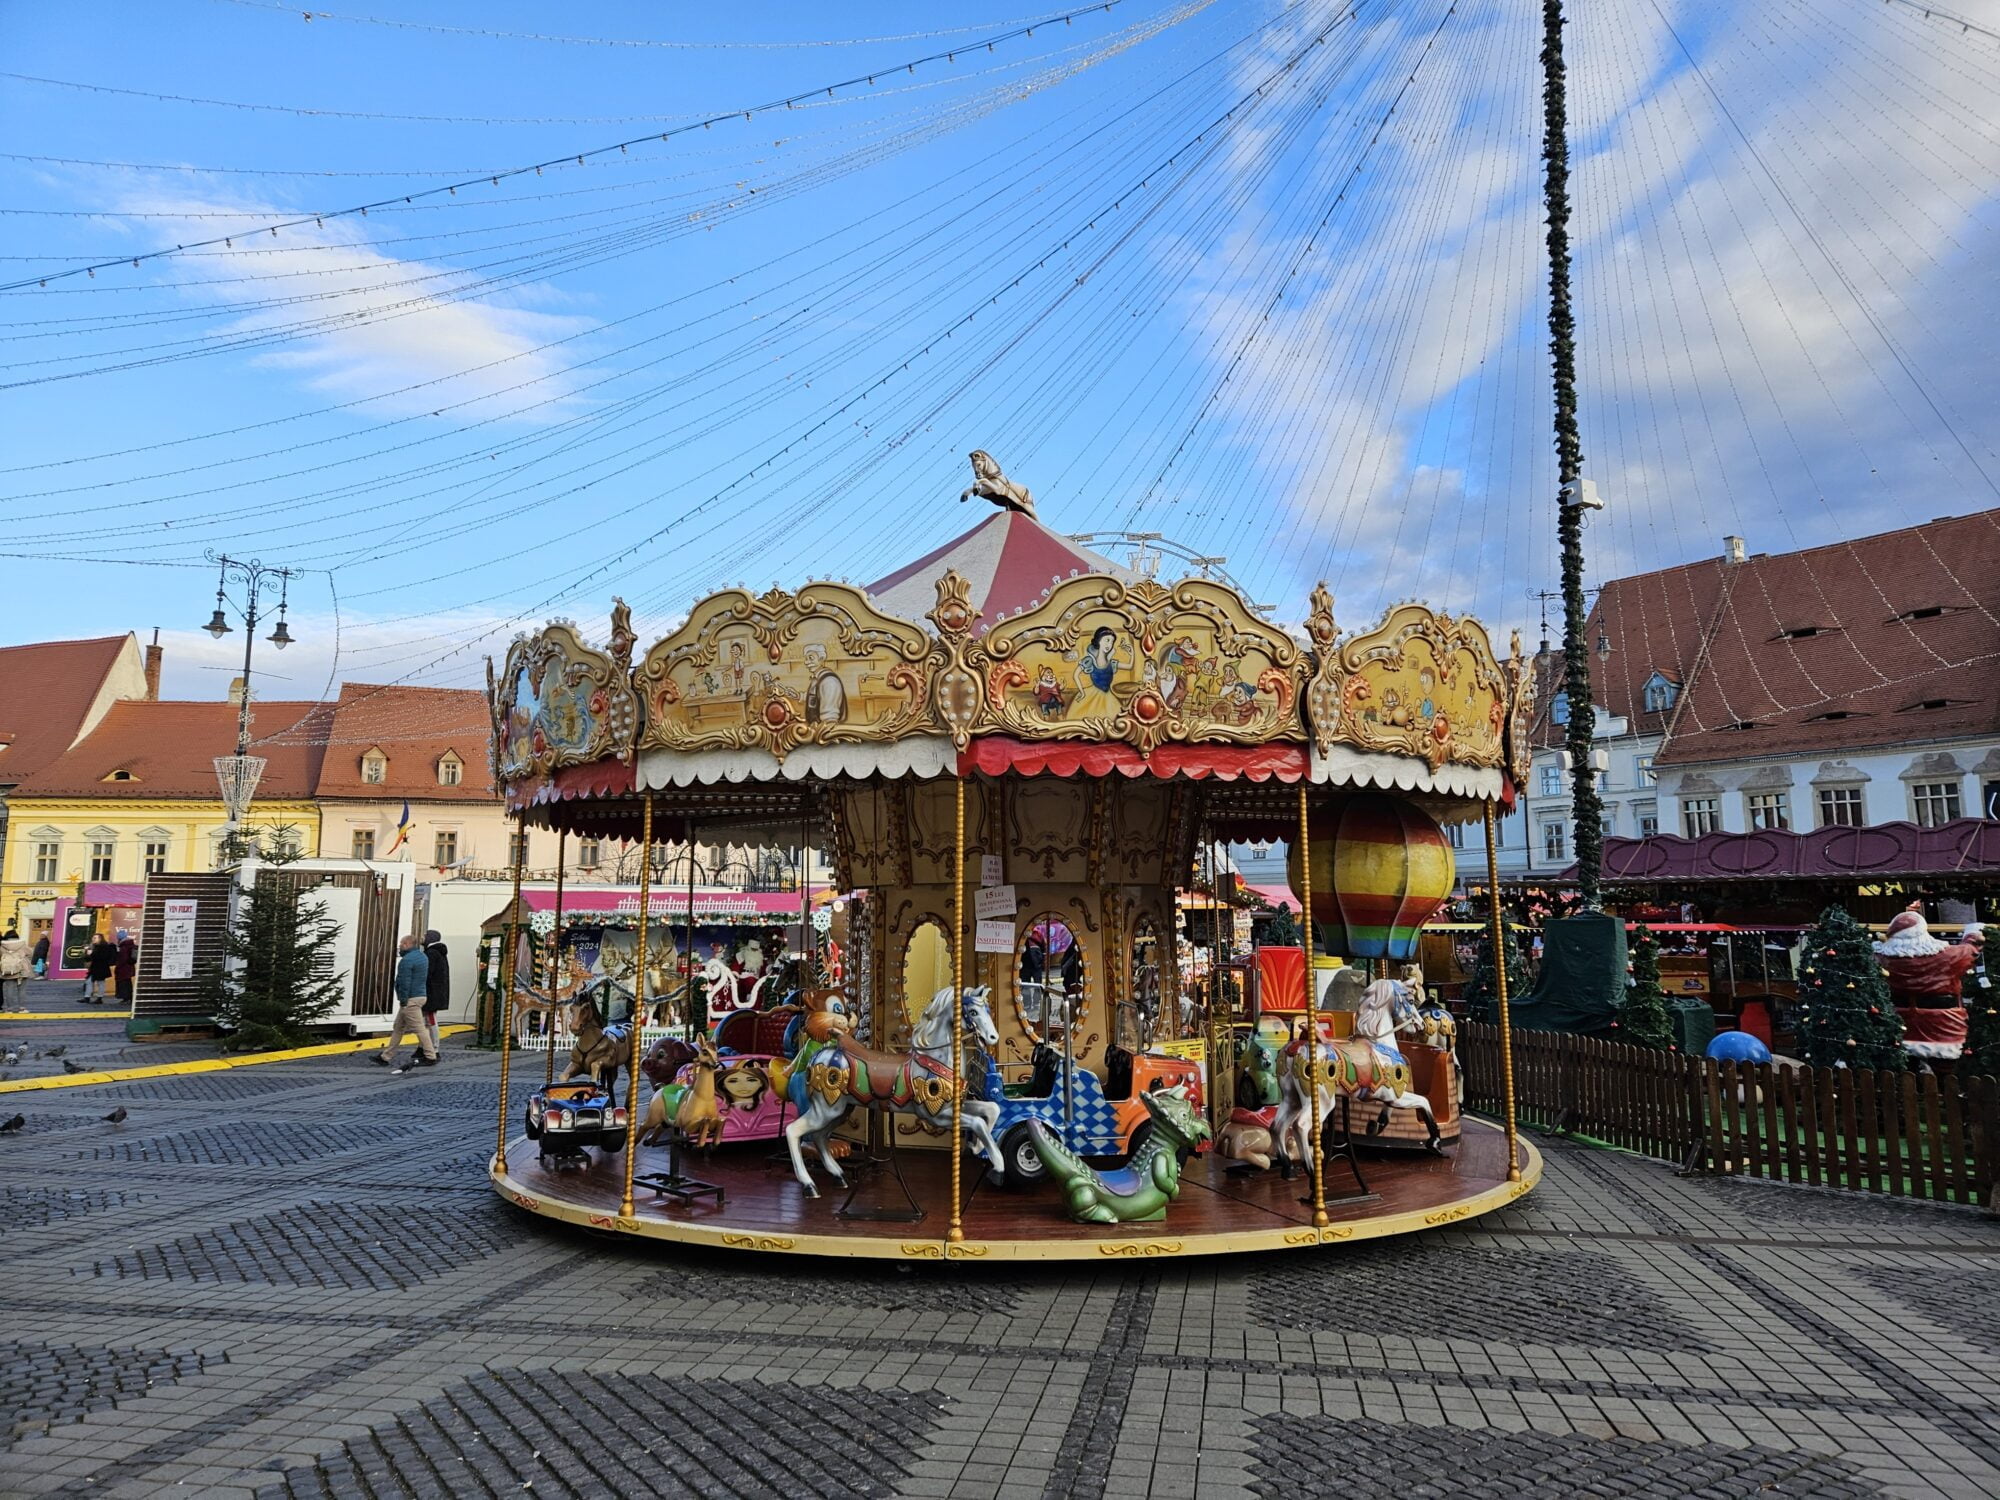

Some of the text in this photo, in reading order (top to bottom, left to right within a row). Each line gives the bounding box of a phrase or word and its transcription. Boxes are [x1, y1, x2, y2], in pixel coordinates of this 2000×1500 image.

[458, 869, 486, 879] Hotel
[985, 891, 994, 899] 15
[168, 905, 193, 913] VIN FIERT
[579, 942, 599, 950] 2024
